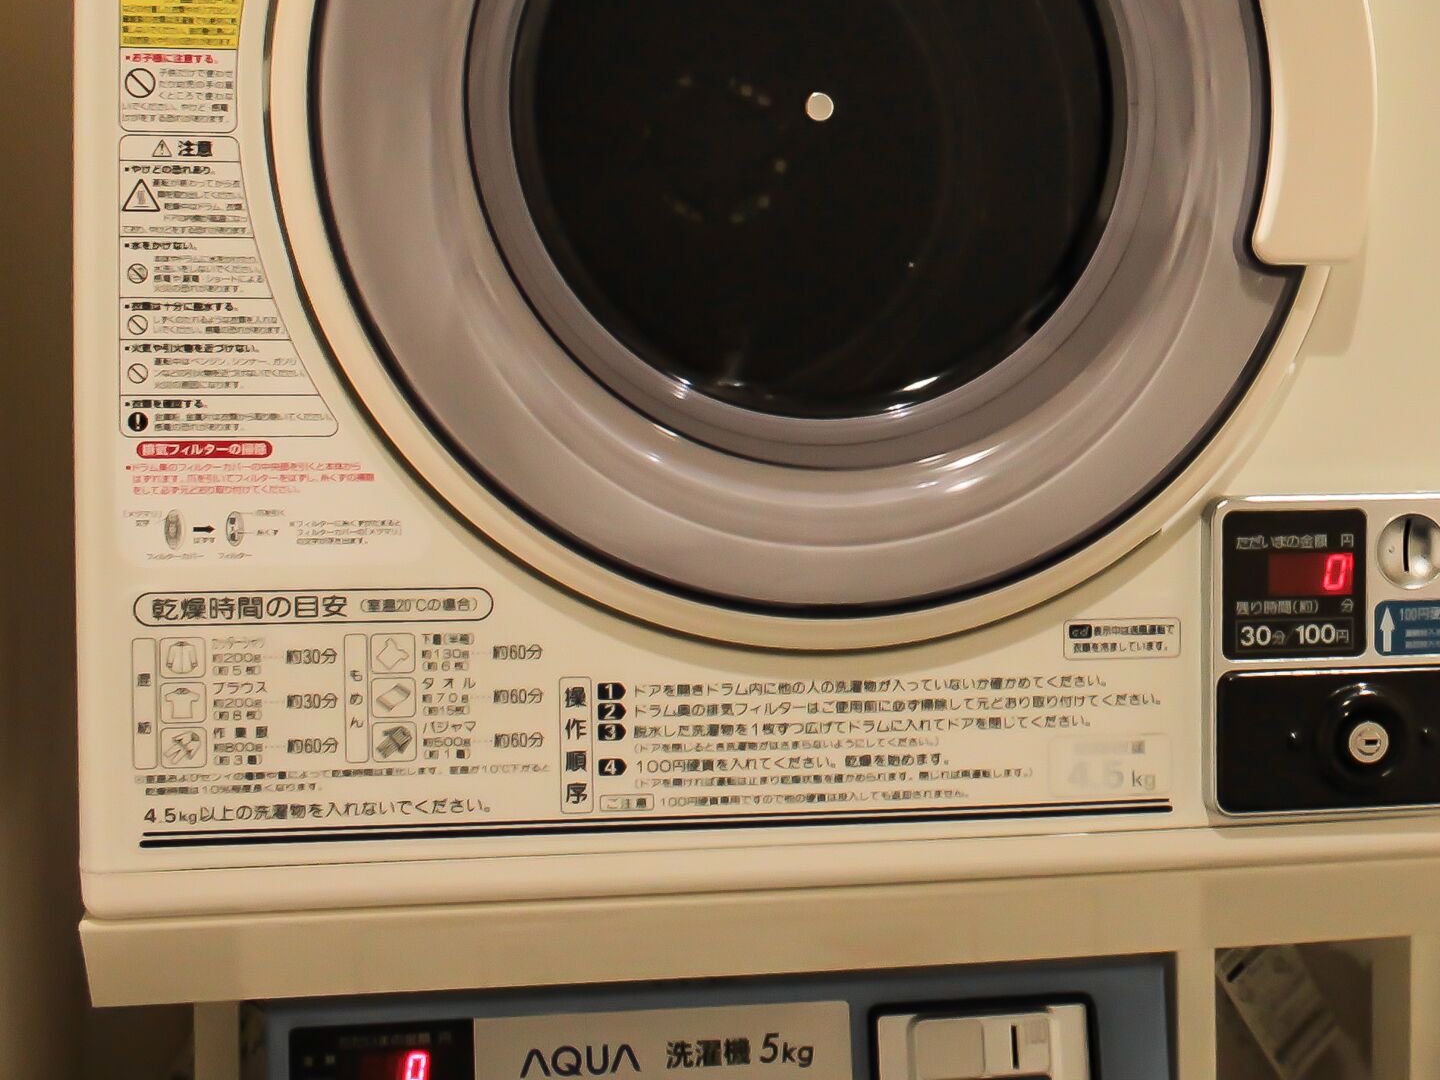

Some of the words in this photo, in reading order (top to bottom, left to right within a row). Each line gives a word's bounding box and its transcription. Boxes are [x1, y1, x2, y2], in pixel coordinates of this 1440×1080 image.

[1340, 533, 1355, 548] 円
[1322, 552, 1348, 591] 0
[151, 596, 349, 620] 乾燥時間の目安
[286, 648, 338, 666] 約30分
[492, 644, 544, 662] 約60分
[212, 681, 268, 695] ブラウス
[493, 688, 545, 706] 約60分
[287, 693, 339, 710] 約30分
[422, 720, 477, 734] パジャマ
[287, 737, 340, 756] 約60分
[493, 731, 545, 749] 約60分
[564, 685, 588, 806] 操作順序
[519, 1043, 642, 1079] AQUA
[666, 1037, 751, 1069] 洗濯機
[759, 1032, 815, 1068] 5kg
